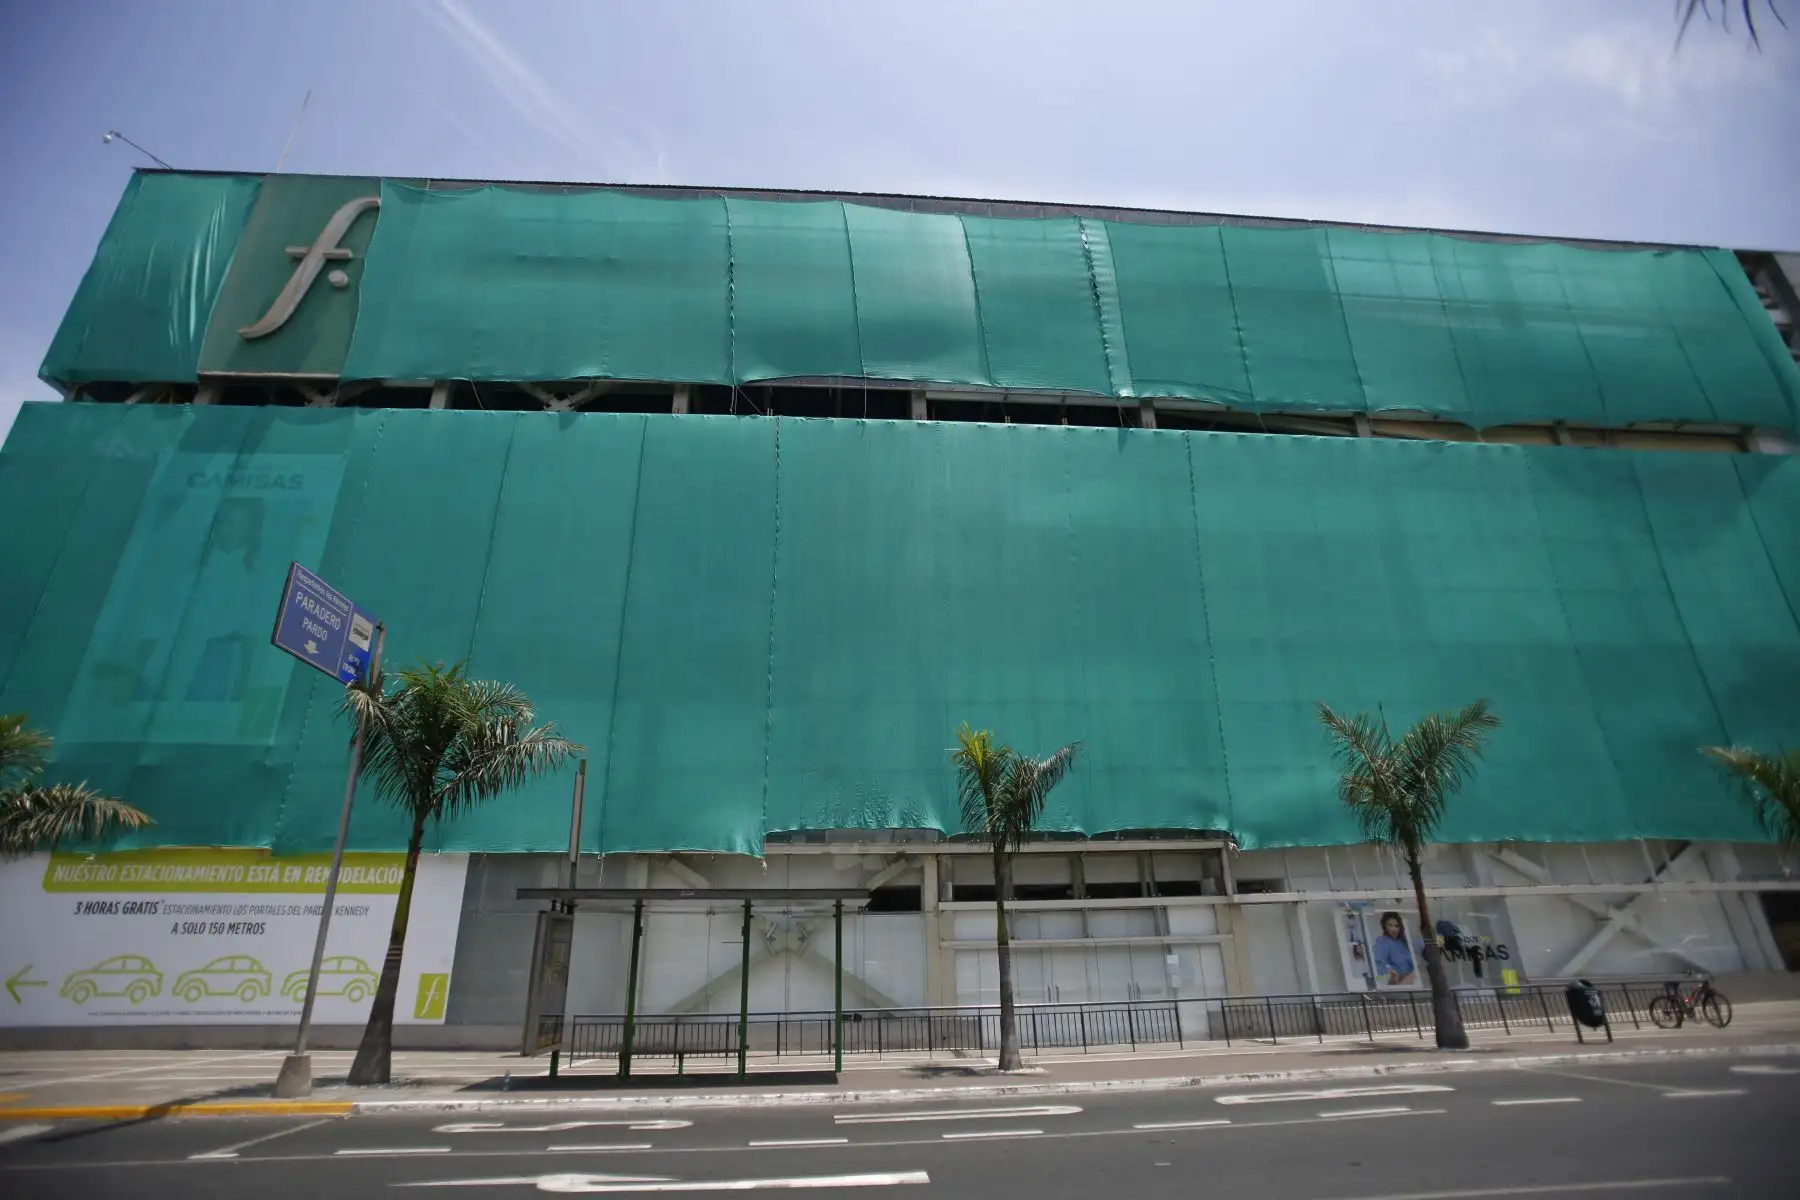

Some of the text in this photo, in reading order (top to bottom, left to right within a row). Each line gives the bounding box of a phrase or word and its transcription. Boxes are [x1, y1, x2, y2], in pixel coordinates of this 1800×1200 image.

[295, 591, 341, 631] PARADERO
[302, 617, 328, 642] PARDO
[53, 864, 118, 882] NUESTRO
[119, 864, 244, 883] ESTACIONAMIENTO
[246, 862, 280, 883] ESTÁ
[282, 865, 303, 883] EN
[74, 901, 83, 915] 3
[83, 901, 121, 915] HORAS
[163, 904, 232, 916] ESTACIONAMIENTO
[232, 904, 248, 916] LOS
[249, 904, 287, 916] PORTALES
[287, 904, 302, 916] DEL
[335, 905, 371, 917] KENNEDY
[171, 922, 266, 935] A SOLO 150 METROS
